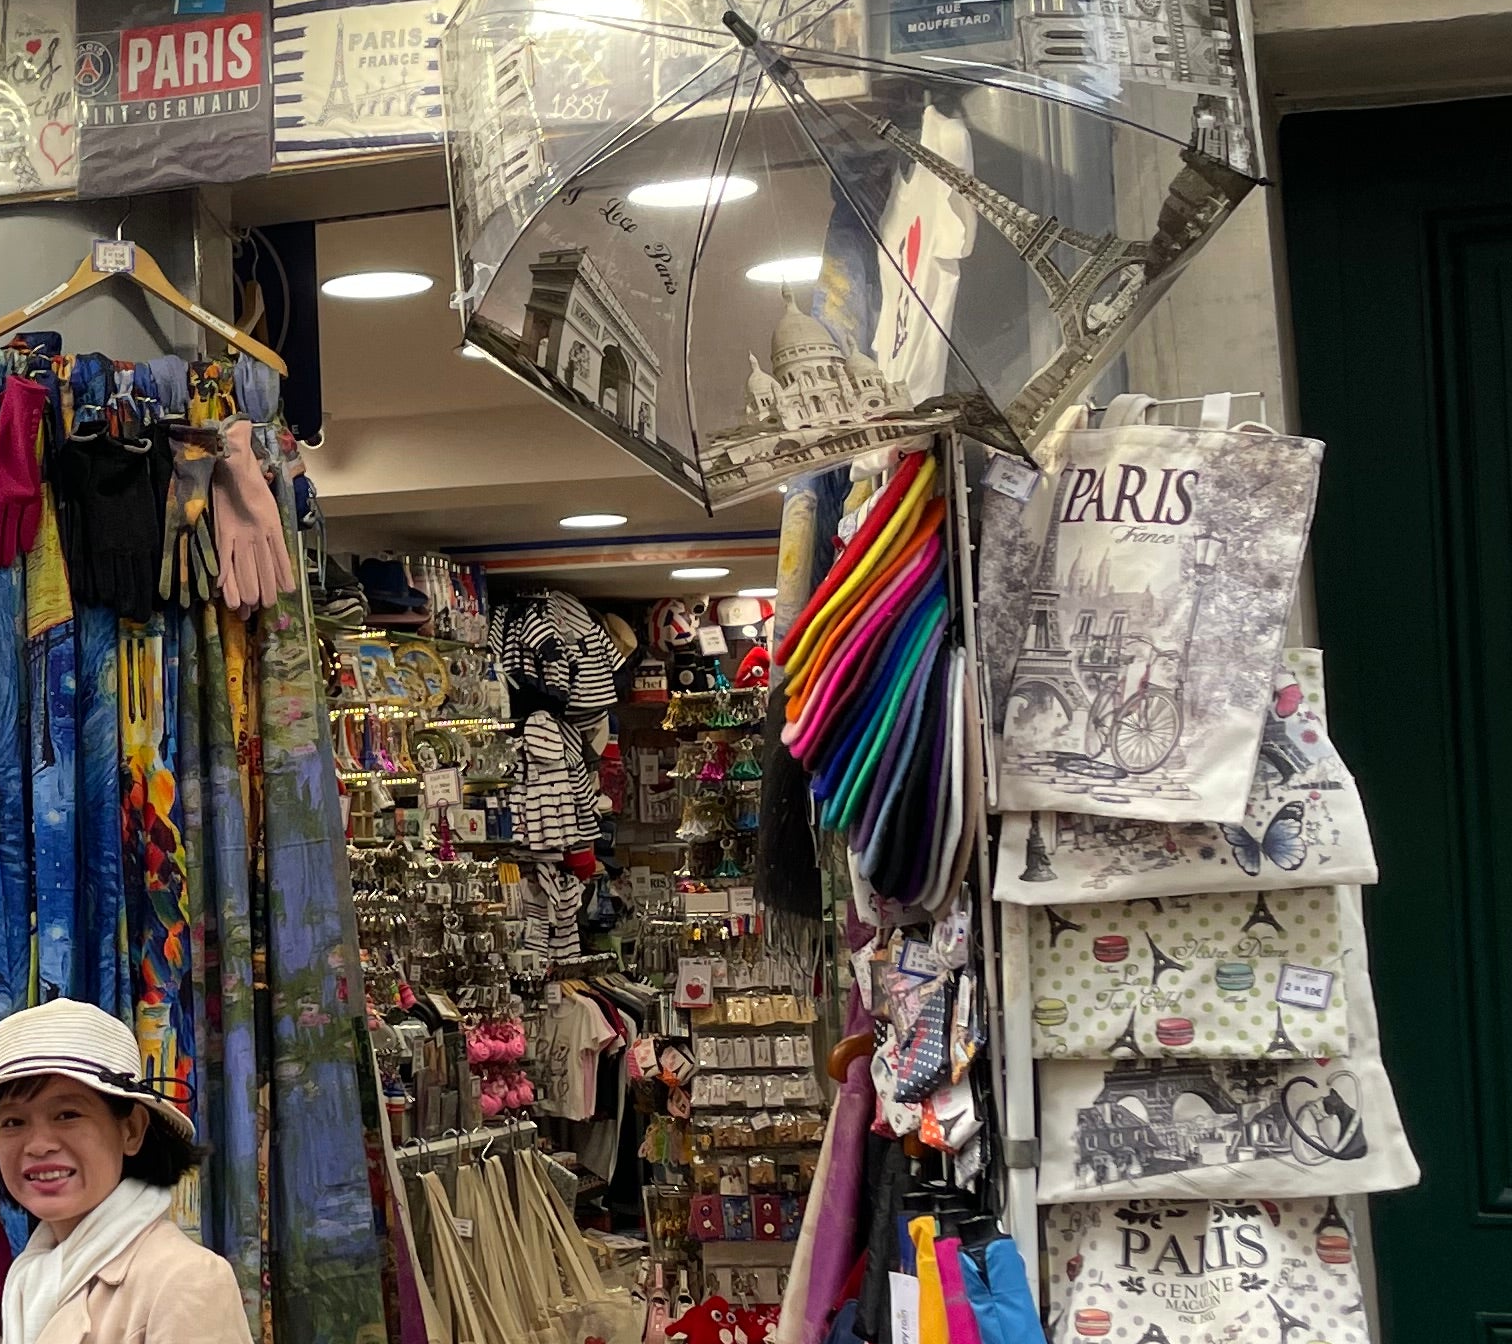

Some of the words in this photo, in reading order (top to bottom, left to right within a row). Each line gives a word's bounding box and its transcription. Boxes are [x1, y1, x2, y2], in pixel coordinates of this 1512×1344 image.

[935, 2, 962, 16] RUE
[907, 12, 992, 34] MOUFFETARD
[348, 27, 423, 52] PARIS
[126, 22, 253, 94] PARIS
[358, 52, 420, 69] FRANCE
[643, 241, 678, 296] Paris
[1060, 463, 1200, 526] PARIS
[1111, 525, 1176, 546] France
